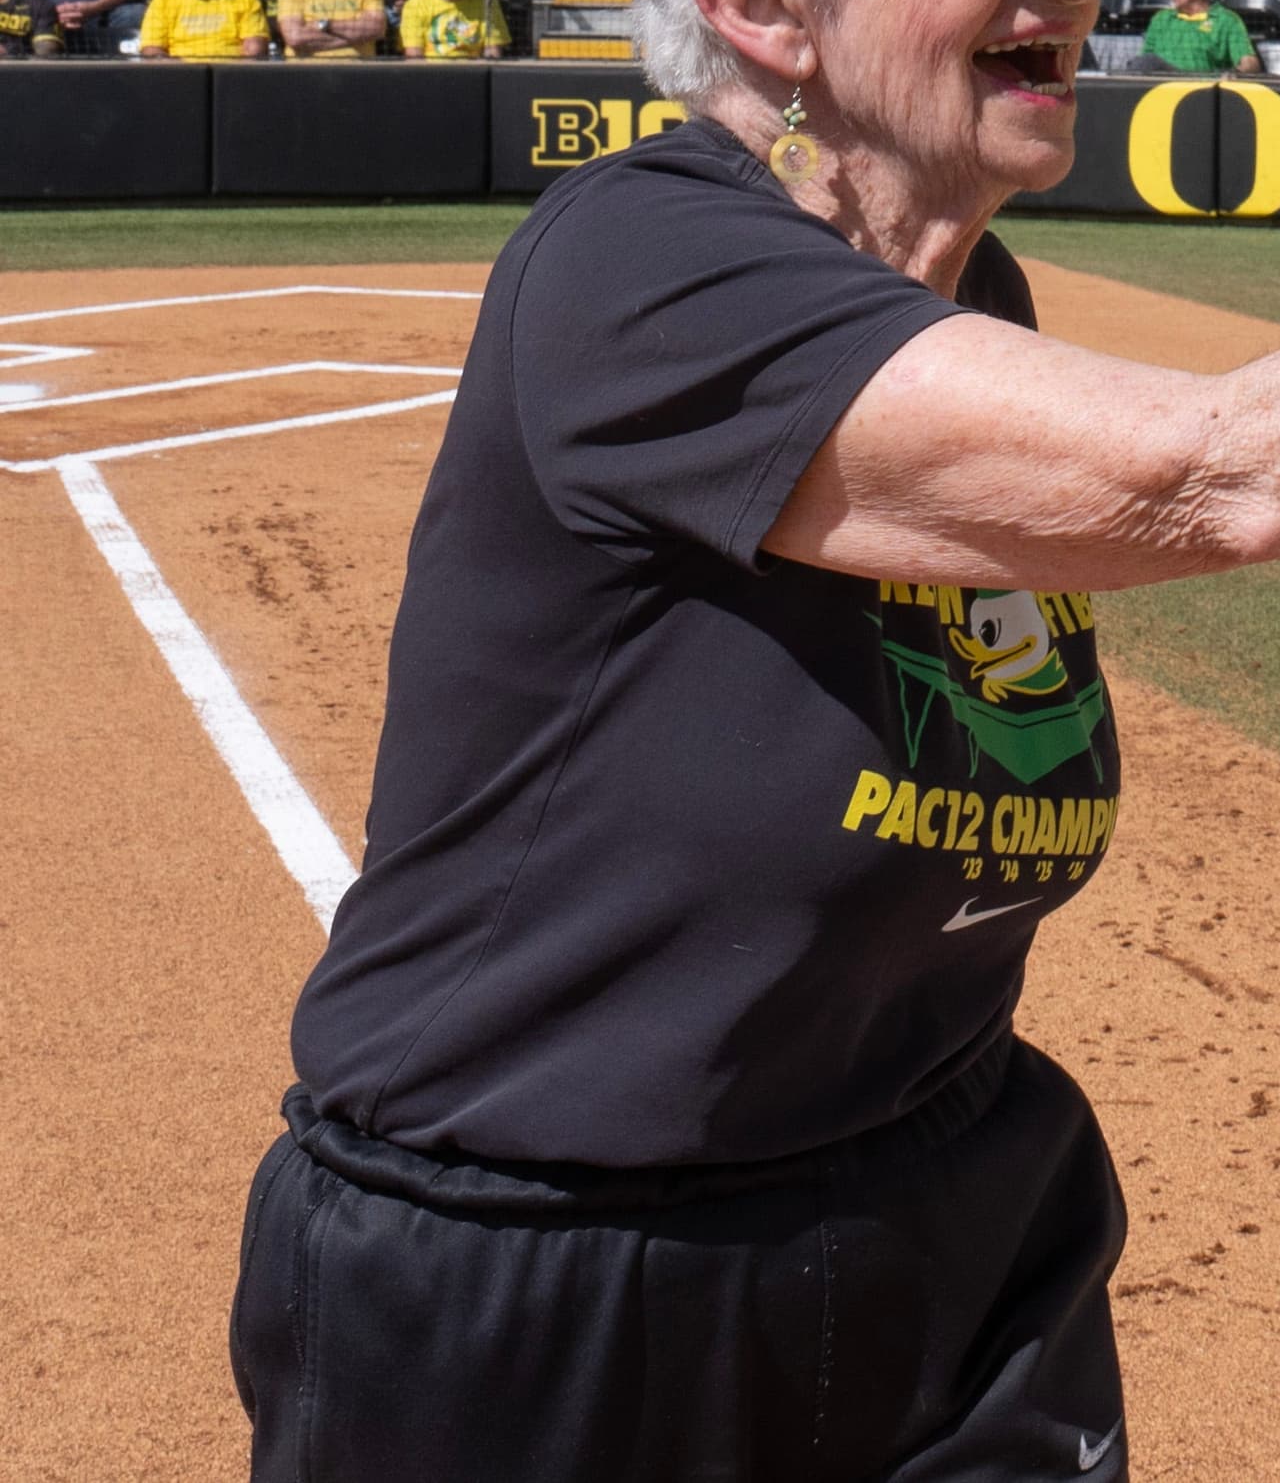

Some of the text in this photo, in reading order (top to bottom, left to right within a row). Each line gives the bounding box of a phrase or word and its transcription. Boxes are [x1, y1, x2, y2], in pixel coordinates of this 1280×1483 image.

[841, 769, 1119, 855] PAC12 CHAMPI
[961, 857, 984, 881] '13
[999, 859, 1020, 883] '14
